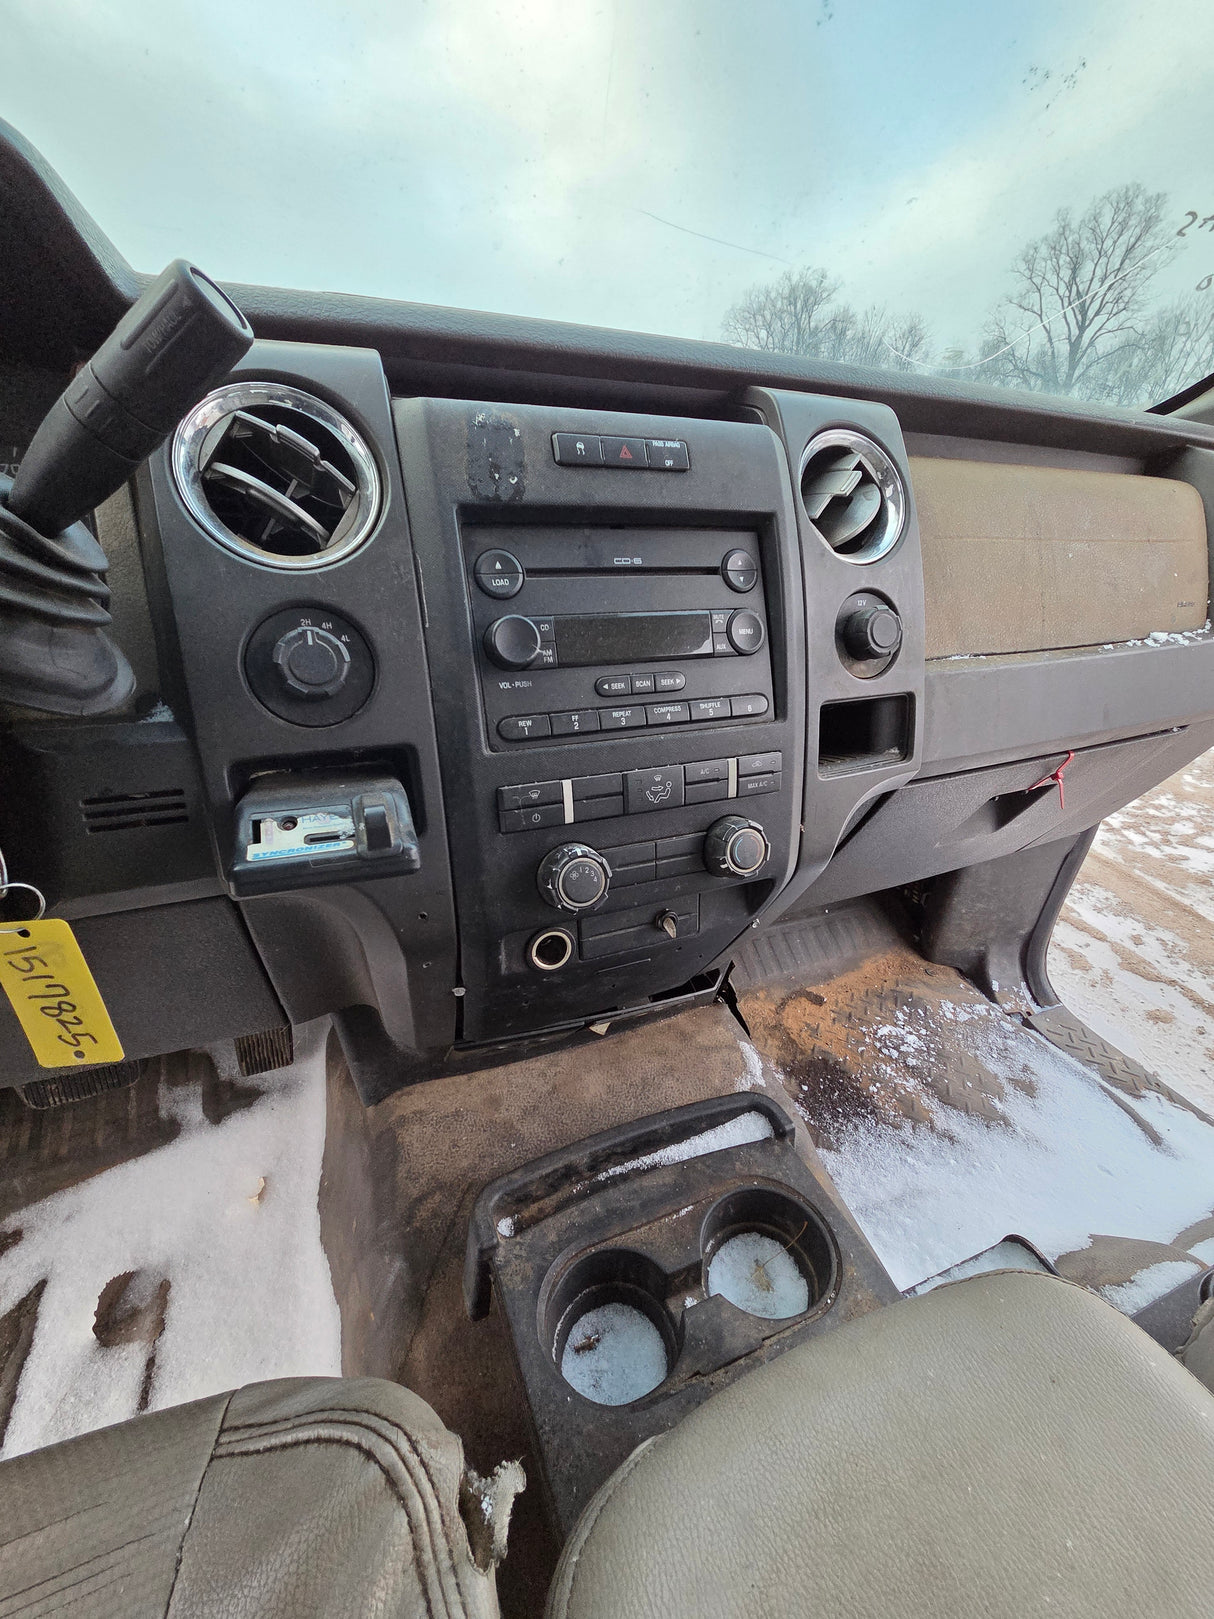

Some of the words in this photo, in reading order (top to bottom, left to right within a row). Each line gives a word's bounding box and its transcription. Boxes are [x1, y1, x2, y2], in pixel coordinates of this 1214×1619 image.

[492, 578, 510, 586] LOAD
[300, 618, 312, 626] 2H
[321, 622, 333, 630] 4H
[340, 634, 351, 642] 4L
[610, 682, 626, 690] SEEK
[635, 680, 651, 688] SCAN
[660, 678, 675, 686] SEEK
[653, 705, 682, 713] COMPRESS
[699, 701, 721, 709] SHUFFLE
[612, 710, 632, 718] REPEAT
[708, 708, 714, 716] 5
[620, 717, 626, 725] 3
[573, 721, 579, 730] 2
[524, 727, 529, 735] 1
[301, 814, 338, 824] HAYE
[584, 866, 590, 874] 2
[3, 946, 98, 1047] 1517825
